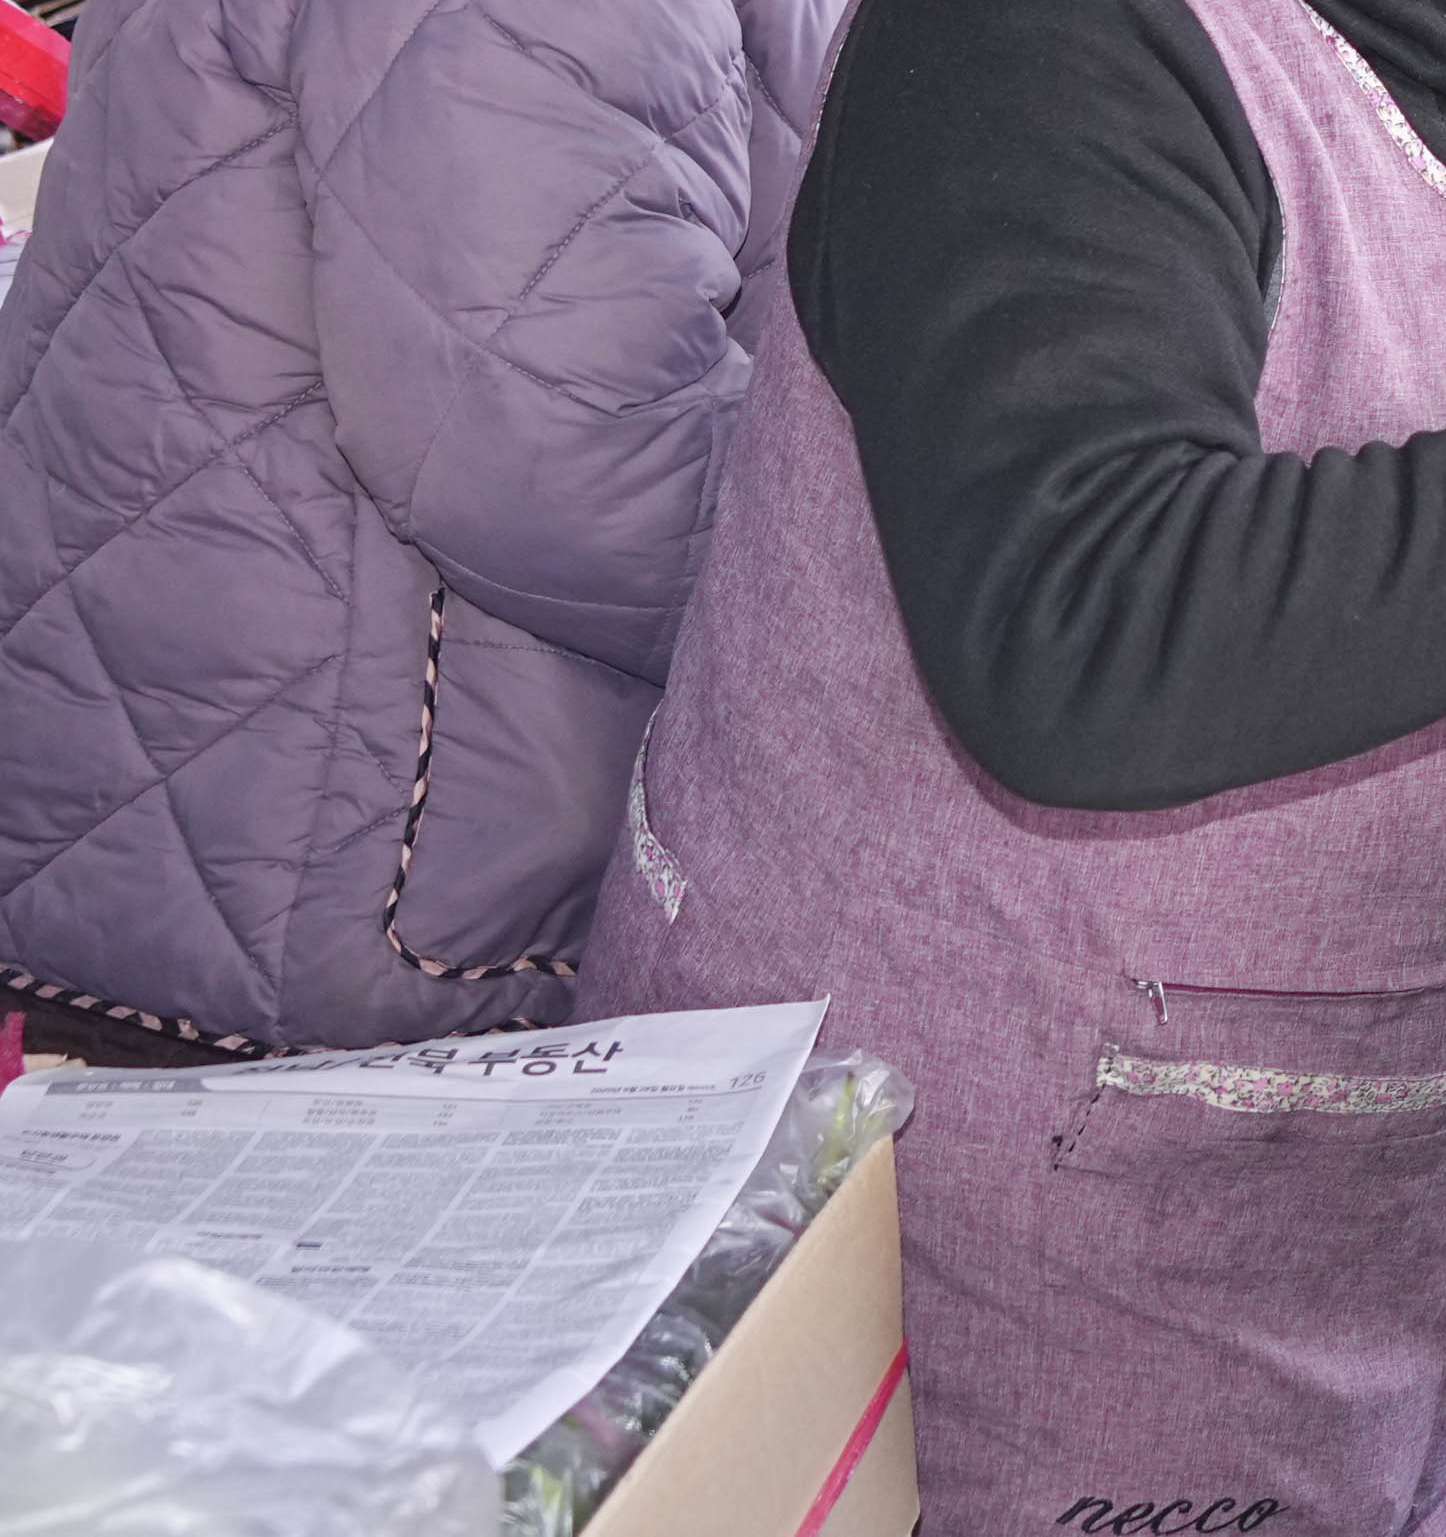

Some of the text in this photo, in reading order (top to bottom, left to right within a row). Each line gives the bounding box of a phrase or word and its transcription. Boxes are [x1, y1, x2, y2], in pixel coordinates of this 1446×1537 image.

[467, 1041, 624, 1077] 부동산
[729, 1069, 767, 1089] 126
[1056, 1496, 1291, 1536] necco
